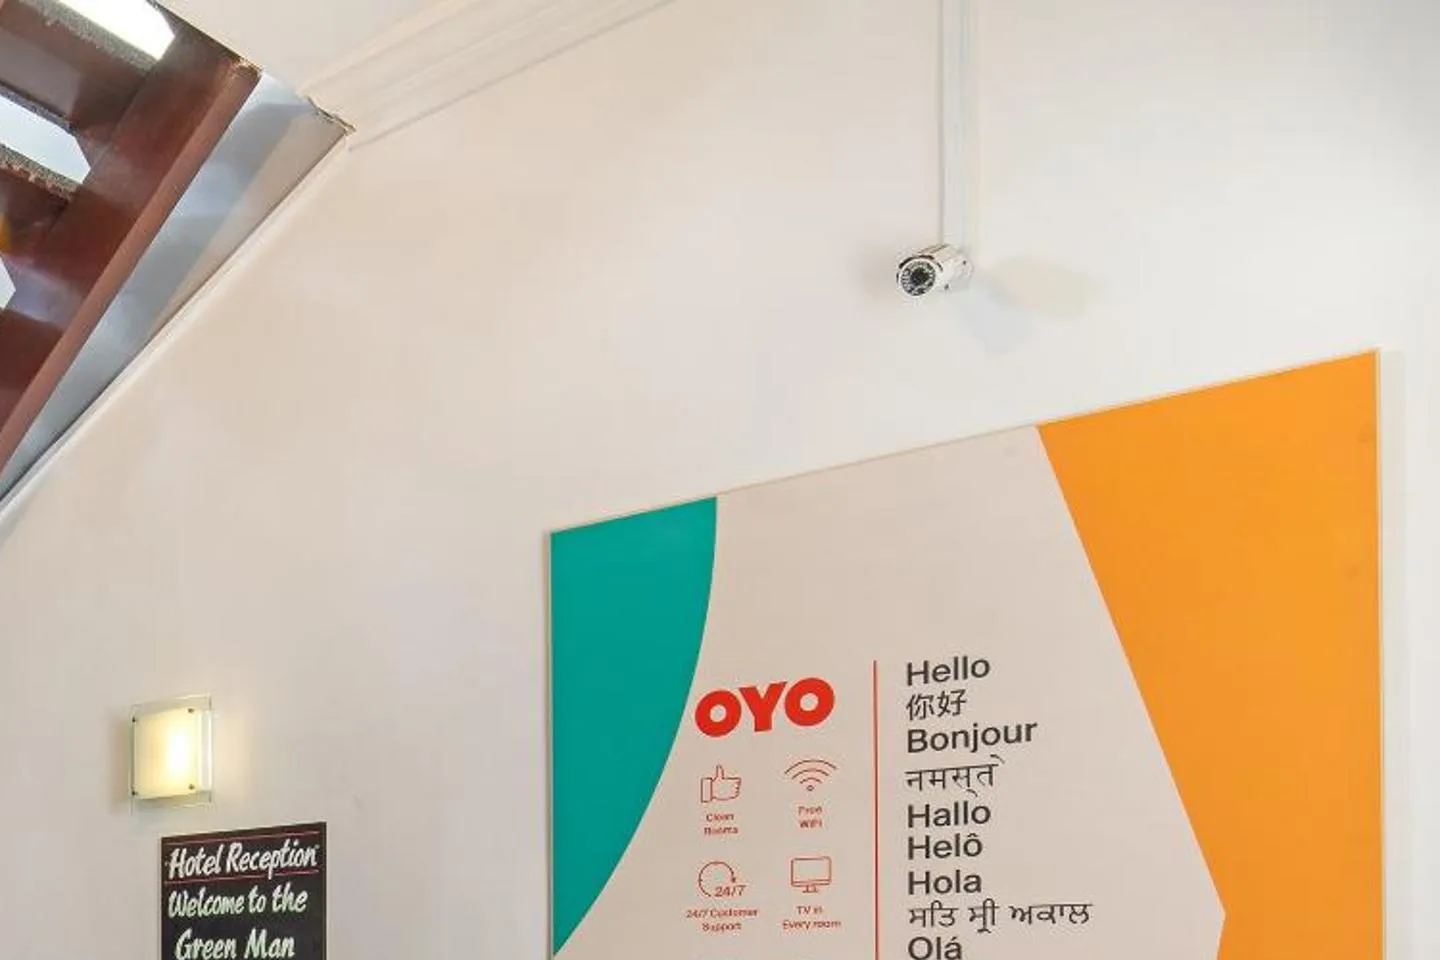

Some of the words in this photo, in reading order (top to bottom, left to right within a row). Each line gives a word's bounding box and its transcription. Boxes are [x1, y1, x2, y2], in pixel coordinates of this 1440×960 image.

[907, 655, 990, 686] Hello
[694, 677, 835, 737] OYO
[906, 689, 967, 721] 你好
[907, 722, 1038, 753] Bonjour
[908, 801, 991, 828] Hallo
[168, 844, 223, 879] Hotel
[226, 838, 318, 879] Reception
[908, 833, 983, 860] Helô
[714, 885, 746, 898] 24/7
[908, 869, 982, 895] Hola
[168, 887, 245, 918] Welcome
[248, 885, 266, 914] to
[272, 882, 308, 912] the
[796, 906, 811, 915] TV
[782, 920, 811, 930] Every
[175, 929, 237, 960] Green
[244, 928, 296, 959] Man
[908, 936, 962, 960] Olá
